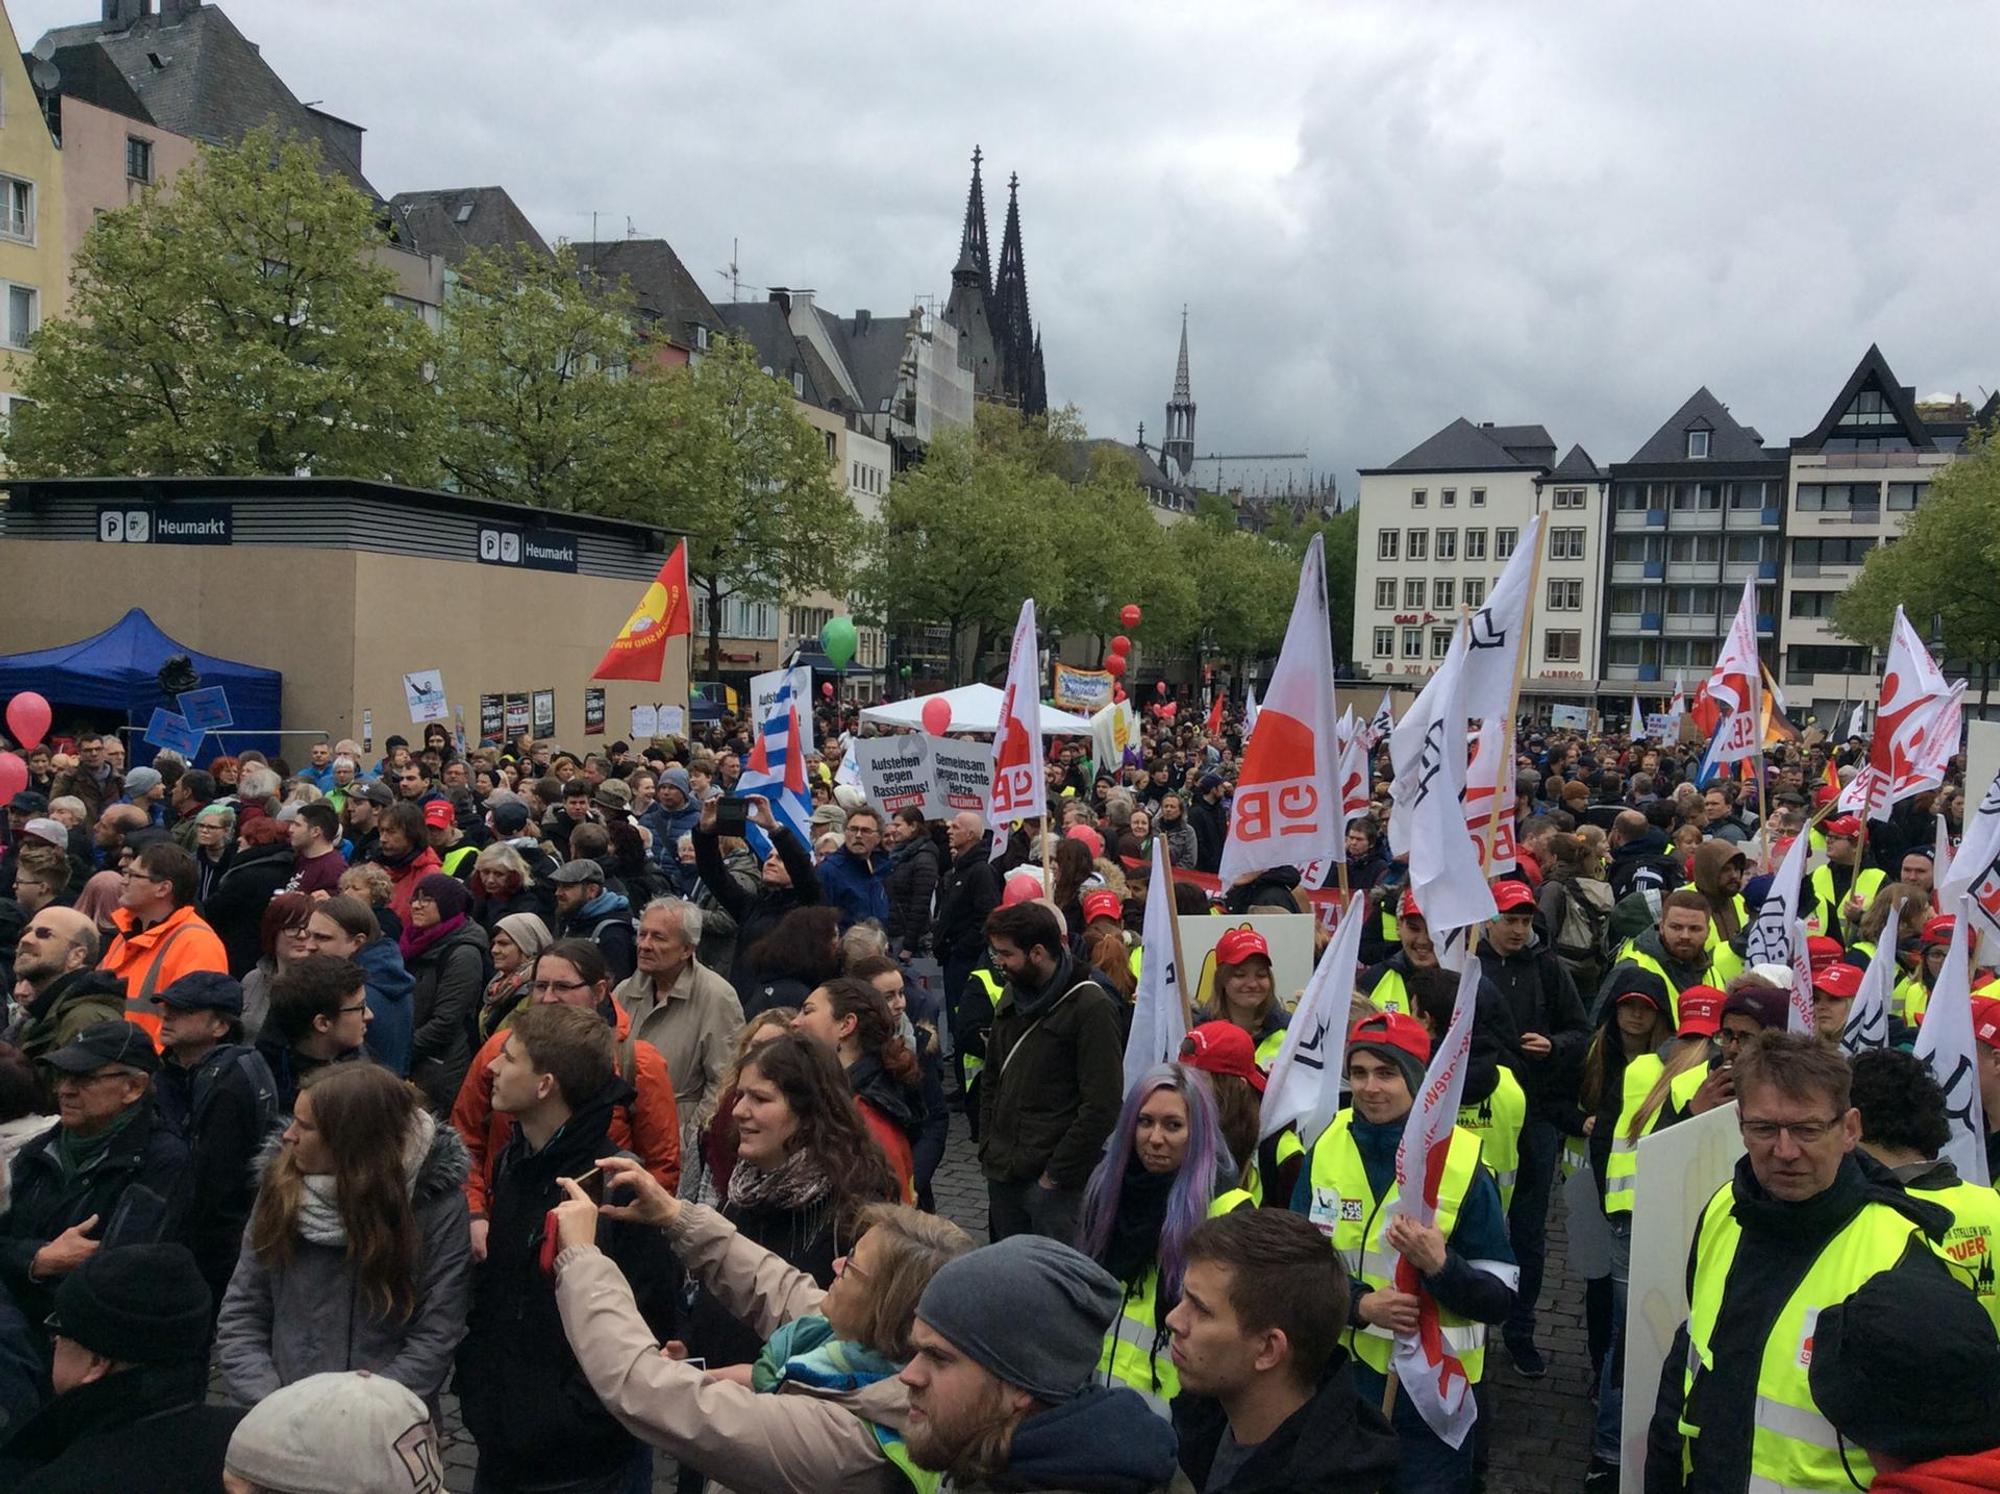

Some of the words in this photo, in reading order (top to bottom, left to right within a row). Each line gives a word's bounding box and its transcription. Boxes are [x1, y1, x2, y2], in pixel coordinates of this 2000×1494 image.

[158, 518, 225, 534] Heumarkt
[526, 543, 573, 561] Heumarkt
[871, 756, 920, 771] Aufstehen
[935, 753, 985, 771] Gemeinsam
[882, 770, 913, 784] gegen
[936, 768, 959, 783] gegen
[960, 772, 990, 786] rechte
[873, 780, 930, 797] Rassismus!
